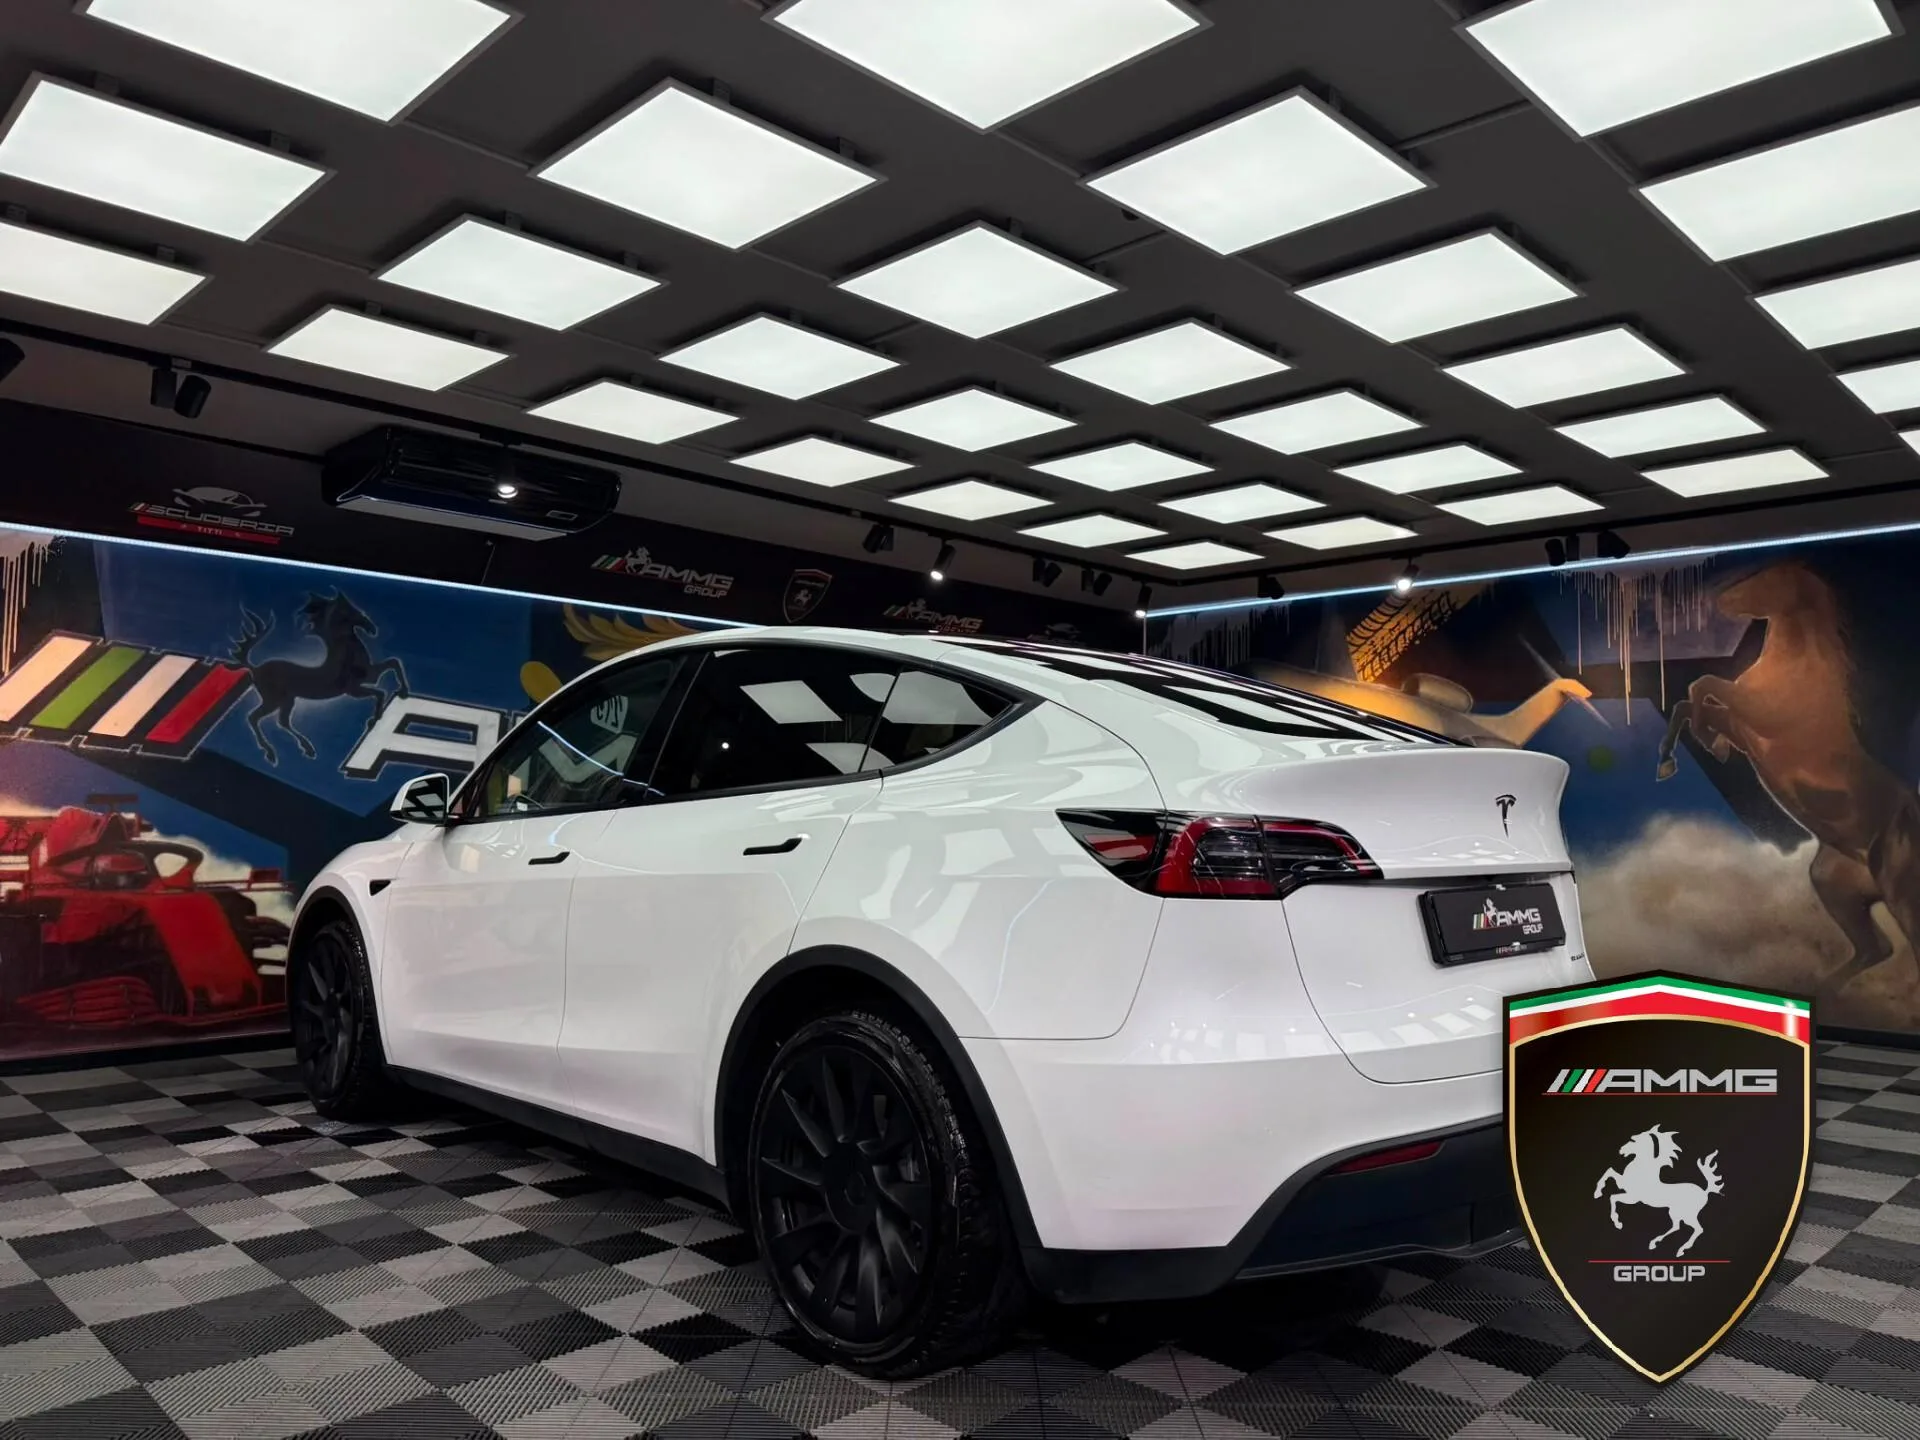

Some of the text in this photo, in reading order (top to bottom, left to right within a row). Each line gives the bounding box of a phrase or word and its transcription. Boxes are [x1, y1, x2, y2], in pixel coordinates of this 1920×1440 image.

[146, 504, 295, 536] SCUDERIA
[639, 562, 735, 590] AMMG
[683, 584, 729, 599] GROUP
[1496, 907, 1542, 927] AMMG
